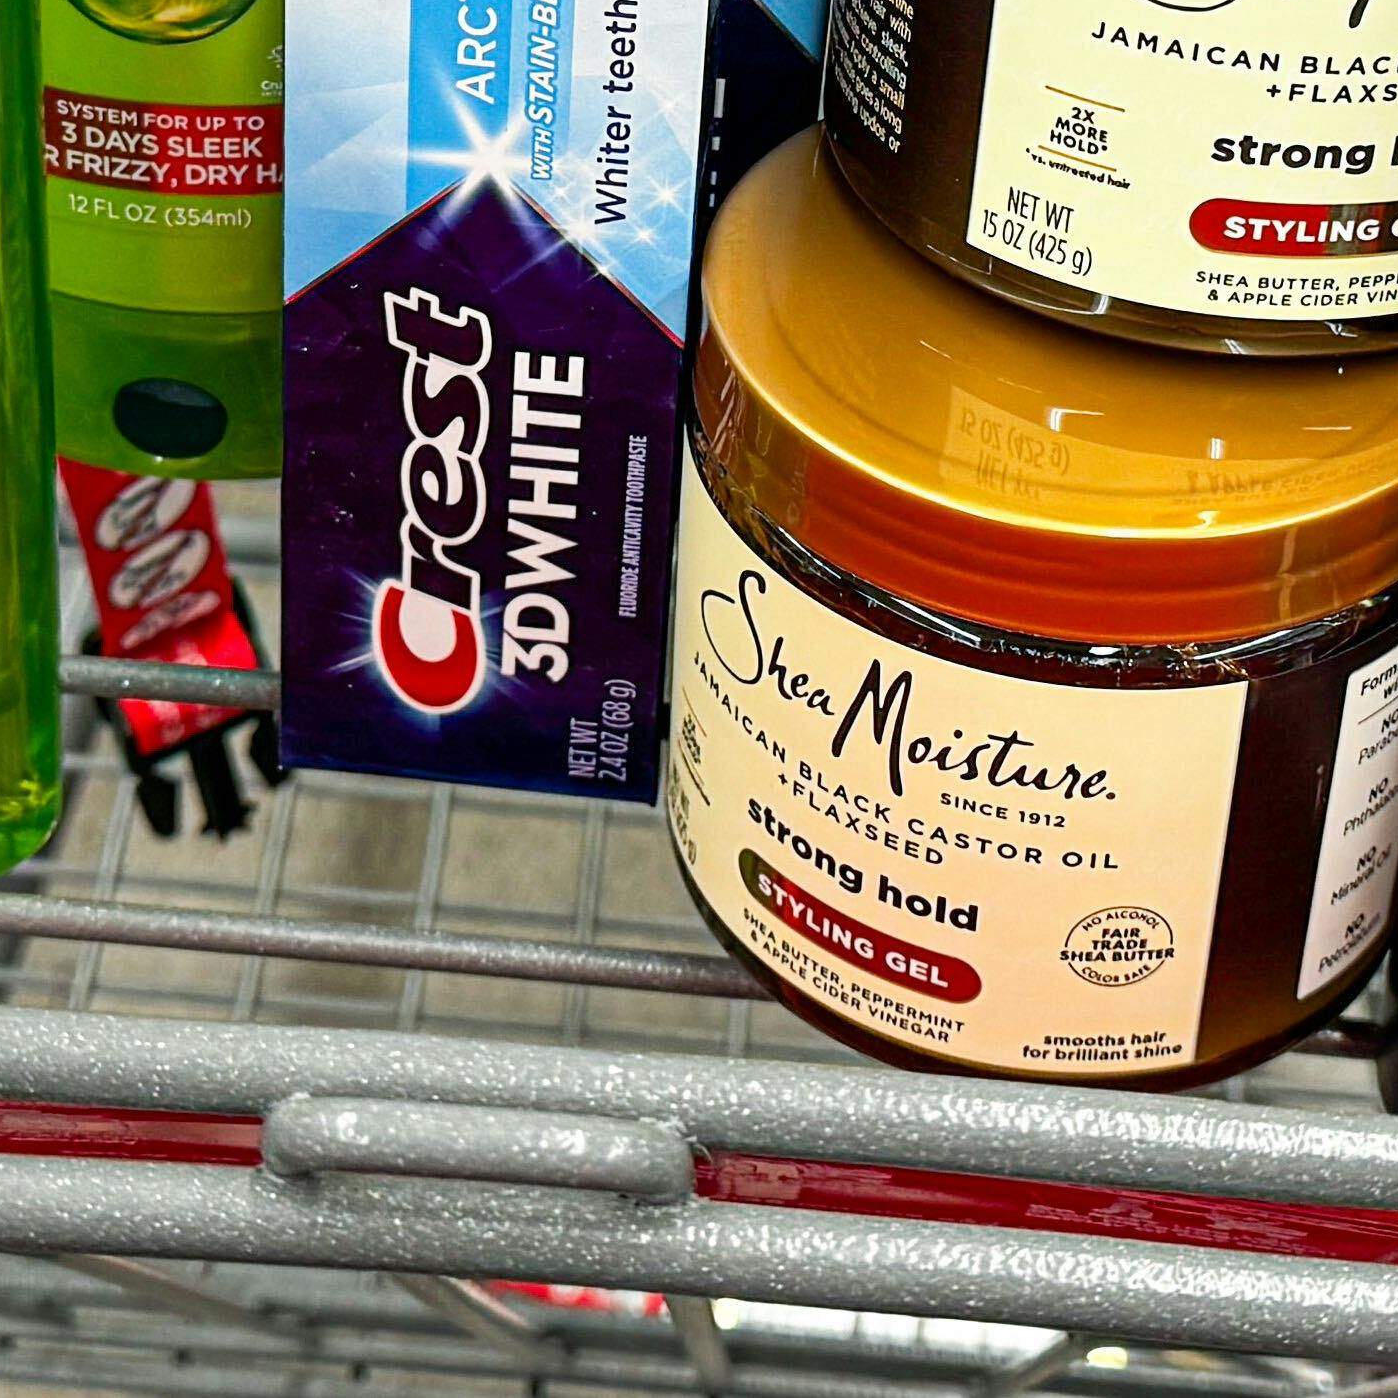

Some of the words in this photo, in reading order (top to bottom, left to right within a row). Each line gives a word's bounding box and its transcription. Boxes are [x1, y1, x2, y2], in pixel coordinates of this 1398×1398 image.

[1092, 21, 1281, 72] JAMAICAN
[57, 100, 138, 127] SYSTEM
[143, 113, 188, 131] FOR
[196, 116, 226, 131] UP
[233, 116, 265, 131] TO
[1055, 117, 1108, 143] MORE
[1071, 107, 1095, 124] 2X
[61, 121, 78, 143] 3
[85, 127, 159, 155] DAYS
[167, 136, 264, 159] SLEEK
[531, 126, 555, 180] WITH
[1211, 134, 1375, 174] strong
[66, 152, 177, 188] FRIZZY,
[185, 164, 248, 185] DRY
[594, 103, 632, 225] Whiter
[1107, 174, 1130, 190] hair
[68, 193, 87, 212] 12
[93, 199, 119, 218] FL
[125, 203, 157, 224] OZ
[164, 208, 252, 228] (354ml)
[1008, 186, 1040, 221] NET
[1046, 200, 1074, 233] WT
[1223, 214, 1380, 243] STYLING
[983, 209, 998, 238] 15
[1002, 219, 1024, 250] OZ
[1029, 230, 1067, 265] (425
[1072, 246, 1092, 276] g)
[1196, 270, 1250, 288] SHEA
[1258, 276, 1340, 292] BUTTER,
[1207, 290, 1220, 303] &
[1228, 290, 1292, 307] APPLE
[1300, 289, 1358, 306] CIDER
[626, 434, 647, 502] TOOTHPASTE
[502, 351, 584, 683] 3DWHITE
[622, 501, 643, 565] ANTICAVITY
[619, 567, 639, 618] FLUORIDE
[570, 717, 598, 743] WT
[568, 746, 597, 778] NET
[693, 651, 786, 765] JAMAICAN
[799, 759, 891, 825] BLACK
[908, 818, 1043, 865] CASTOR
[1061, 849, 1119, 870] OIL
[777, 772, 944, 866] +FLAXSEED
[940, 792, 1009, 821] SINCE
[1019, 810, 1066, 828] 1912
[747, 796, 864, 896] strong
[879, 872, 978, 932] hold
[757, 872, 876, 961] STYLING
[885, 949, 949, 989] GEL
[1102, 928, 1140, 938] FAIR
[743, 907, 778, 946] SHEA
[781, 937, 846, 992] BUTTER,
[851, 984, 965, 1033] PEPPERMINT
[1044, 1034, 1124, 1046] smooths
[1131, 1030, 1167, 1045] hair
